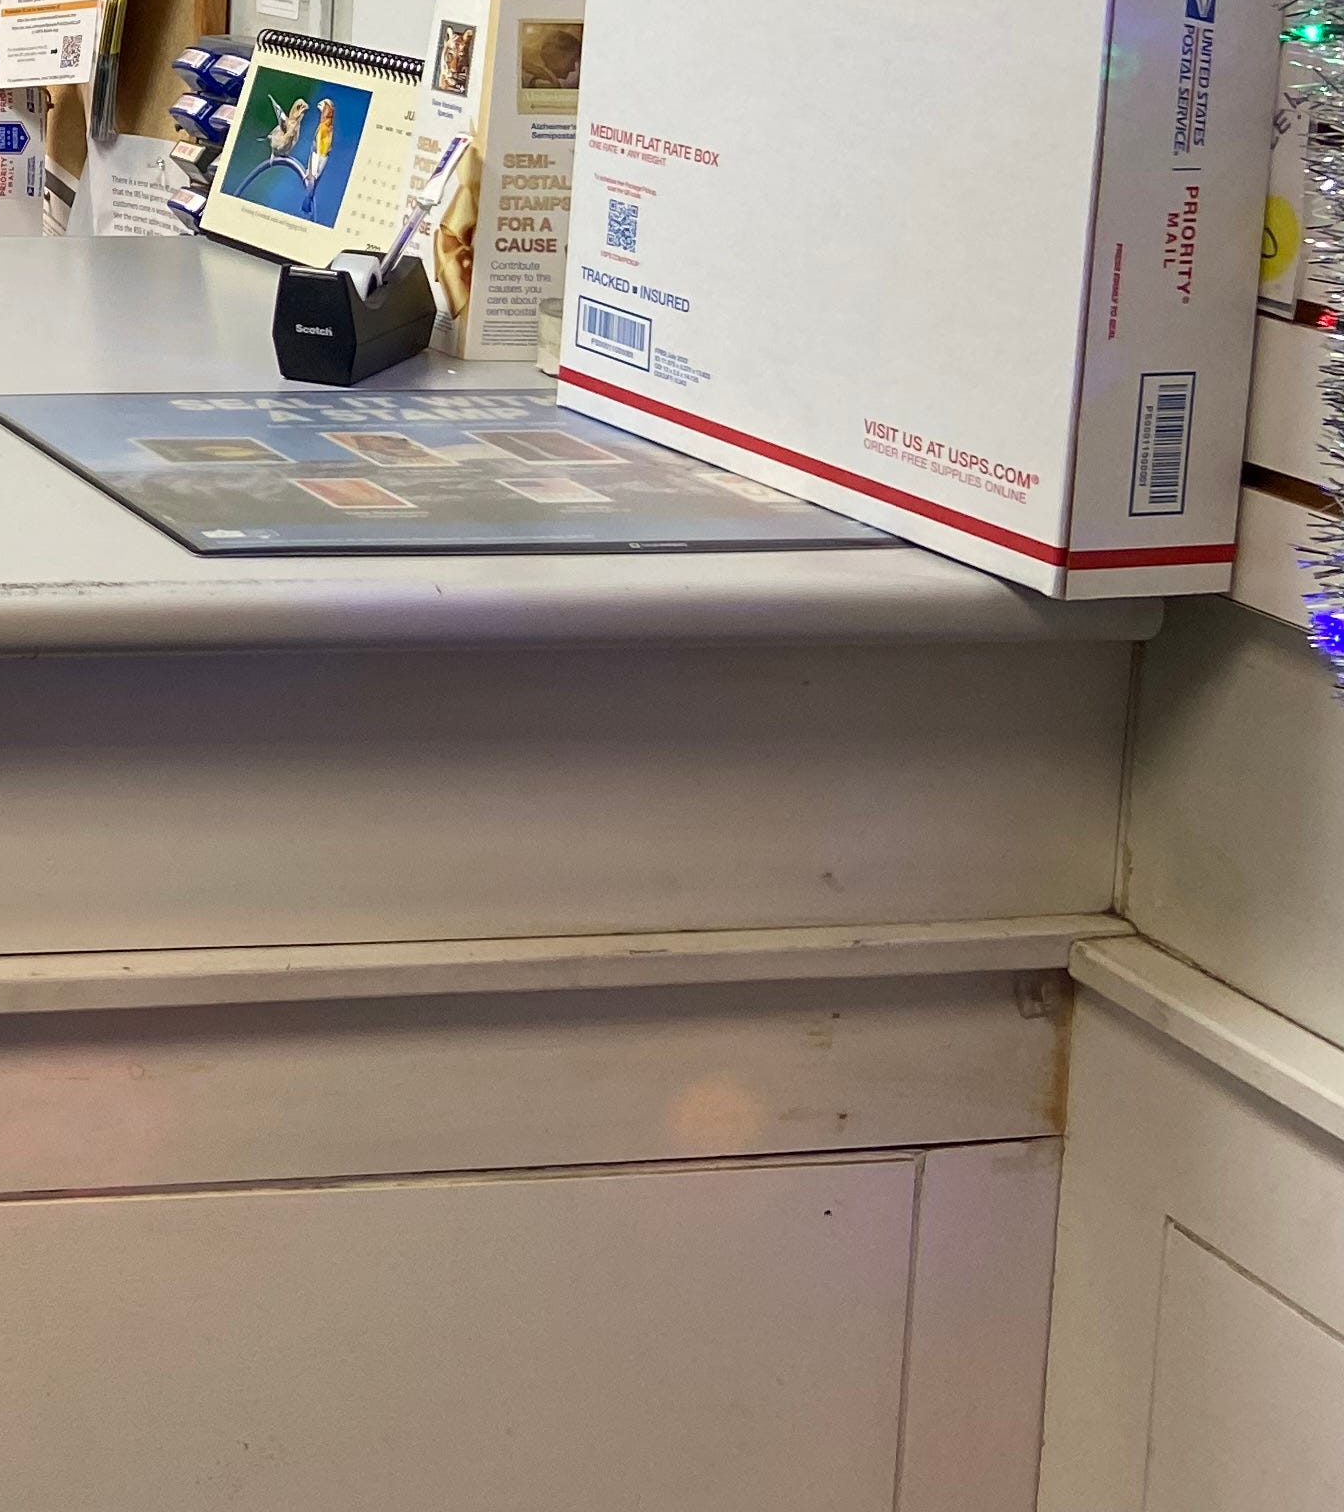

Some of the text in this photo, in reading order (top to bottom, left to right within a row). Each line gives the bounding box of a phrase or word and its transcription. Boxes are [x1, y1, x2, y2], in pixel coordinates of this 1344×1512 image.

[1174, 23, 1195, 156] POSTAL SERVICE
[1194, 28, 1214, 146] UNITED STATES
[590, 123, 720, 167] MEDIUM FLAT RATE BOX
[503, 153, 556, 168] SEMI-
[502, 175, 572, 190] POSTAL
[497, 217, 552, 231] FOR A
[495, 238, 557, 253] CAUSE
[1163, 212, 1179, 269] MAIL
[490, 273, 521, 283] money
[537, 273, 551, 281] the
[491, 261, 541, 270] Contribute
[581, 266, 690, 312] TRACKED INSURED
[295, 323, 333, 337] Scotch
[864, 419, 898, 442] VISIT
[903, 431, 922, 451] US
[926, 441, 944, 458] AT
[864, 438, 1027, 504] ORDER FREE SUPPLIES ONLINE
